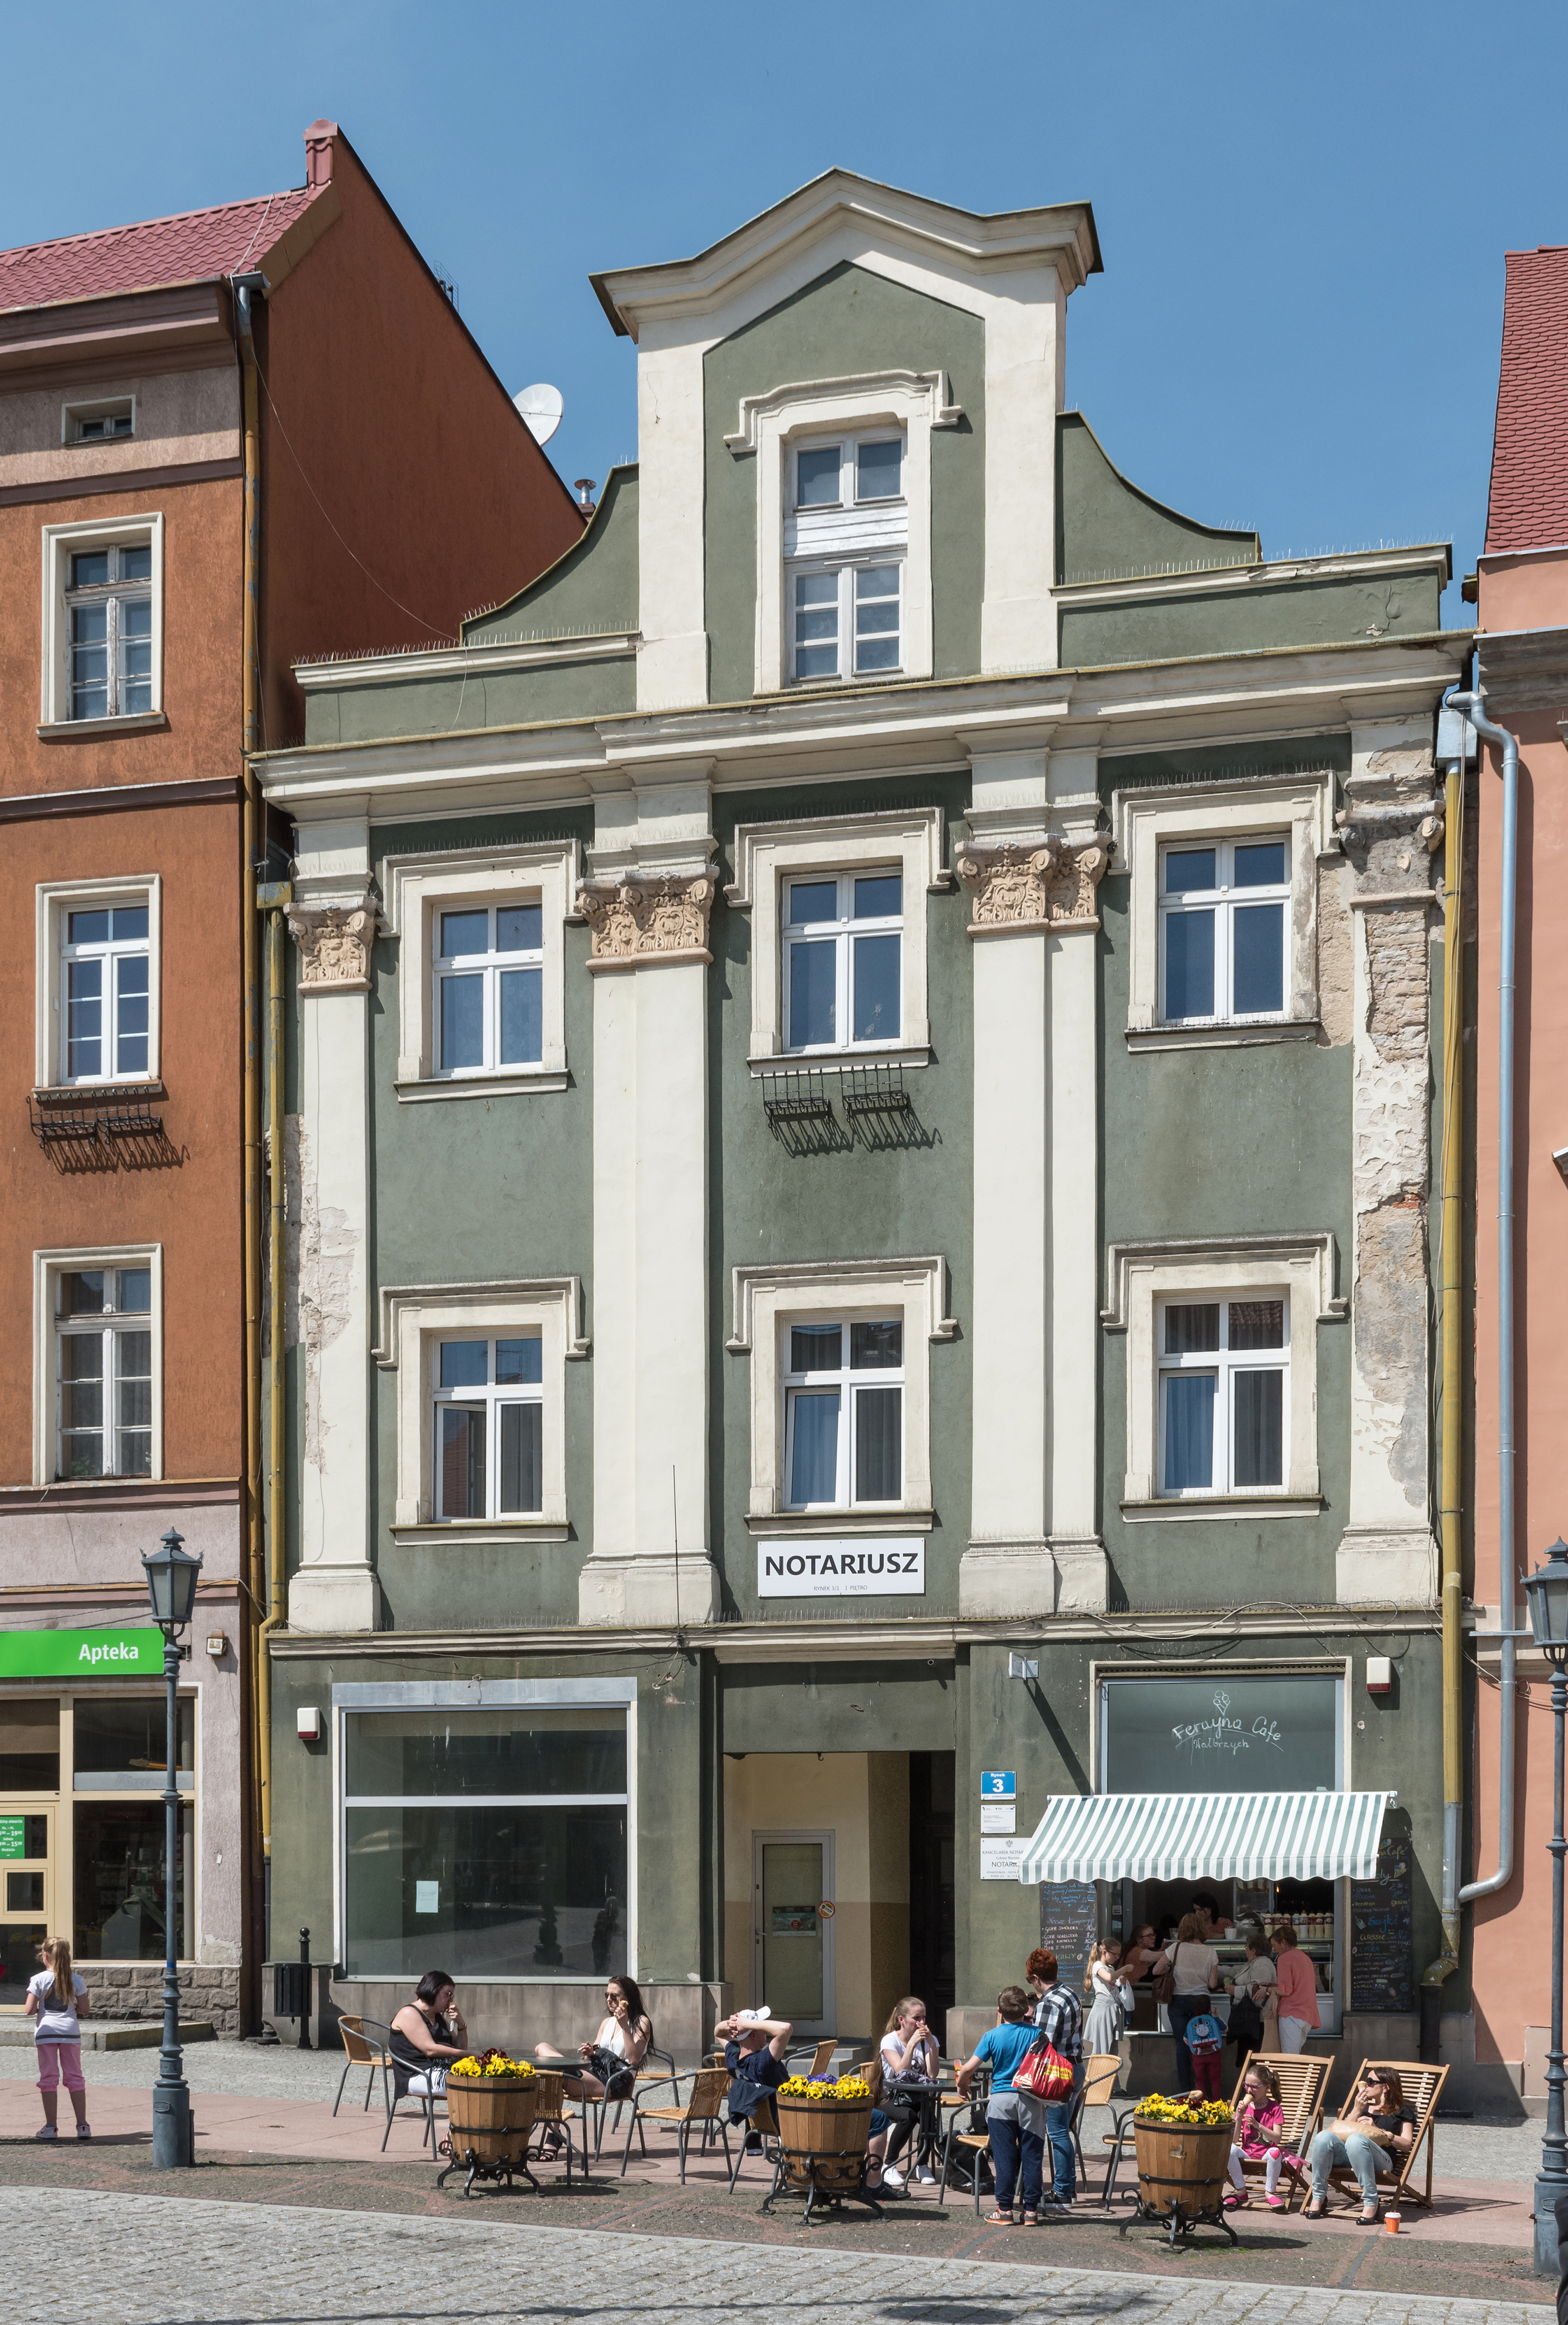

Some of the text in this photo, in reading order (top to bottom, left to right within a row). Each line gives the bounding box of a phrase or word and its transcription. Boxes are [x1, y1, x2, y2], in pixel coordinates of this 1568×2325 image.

[766, 1553, 918, 1576] NOTARIUSZ
[79, 1642, 139, 1664] Apteka
[1172, 1716, 1281, 1742] Ferayna Cafe
[992, 1779, 1004, 1792] 3
